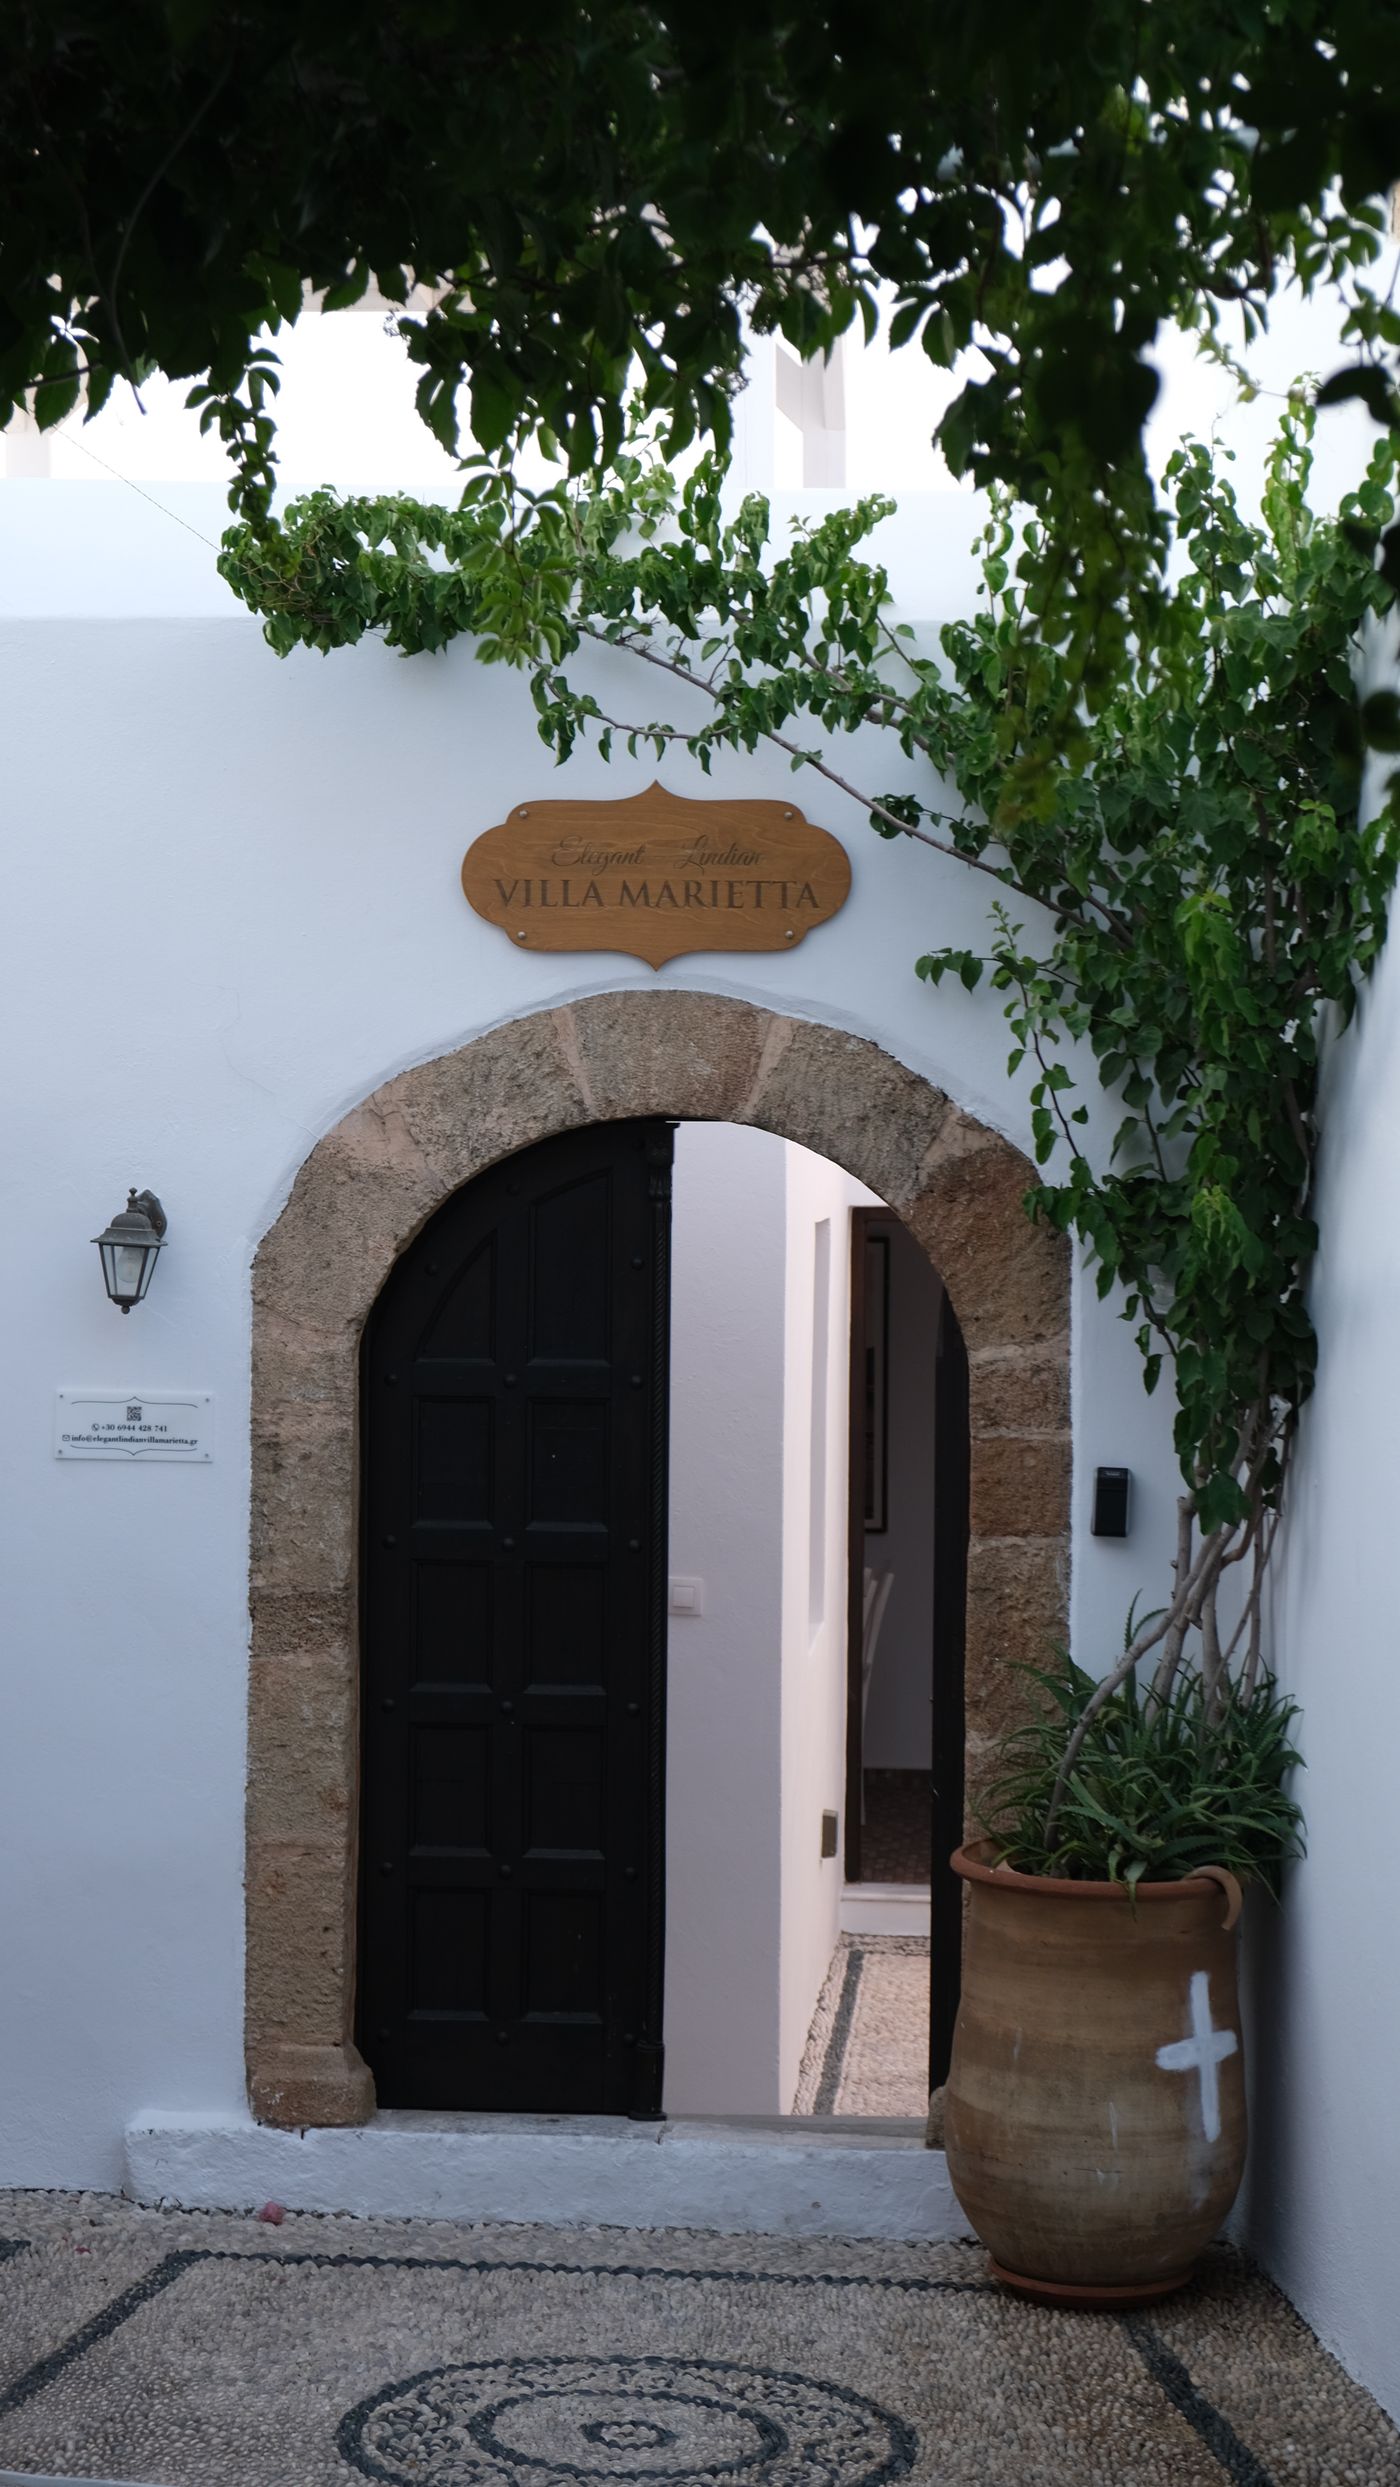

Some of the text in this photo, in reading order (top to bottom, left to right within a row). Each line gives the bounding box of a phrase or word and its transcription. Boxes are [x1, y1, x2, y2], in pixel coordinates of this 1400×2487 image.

[551, 834, 765, 875] Elegant Lindian
[494, 879, 820, 909] VILLA MARIETTA
[139, 1424, 152, 1432] 428
[71, 1434, 198, 1446] info@elegantlindianvillamarietta.gr
